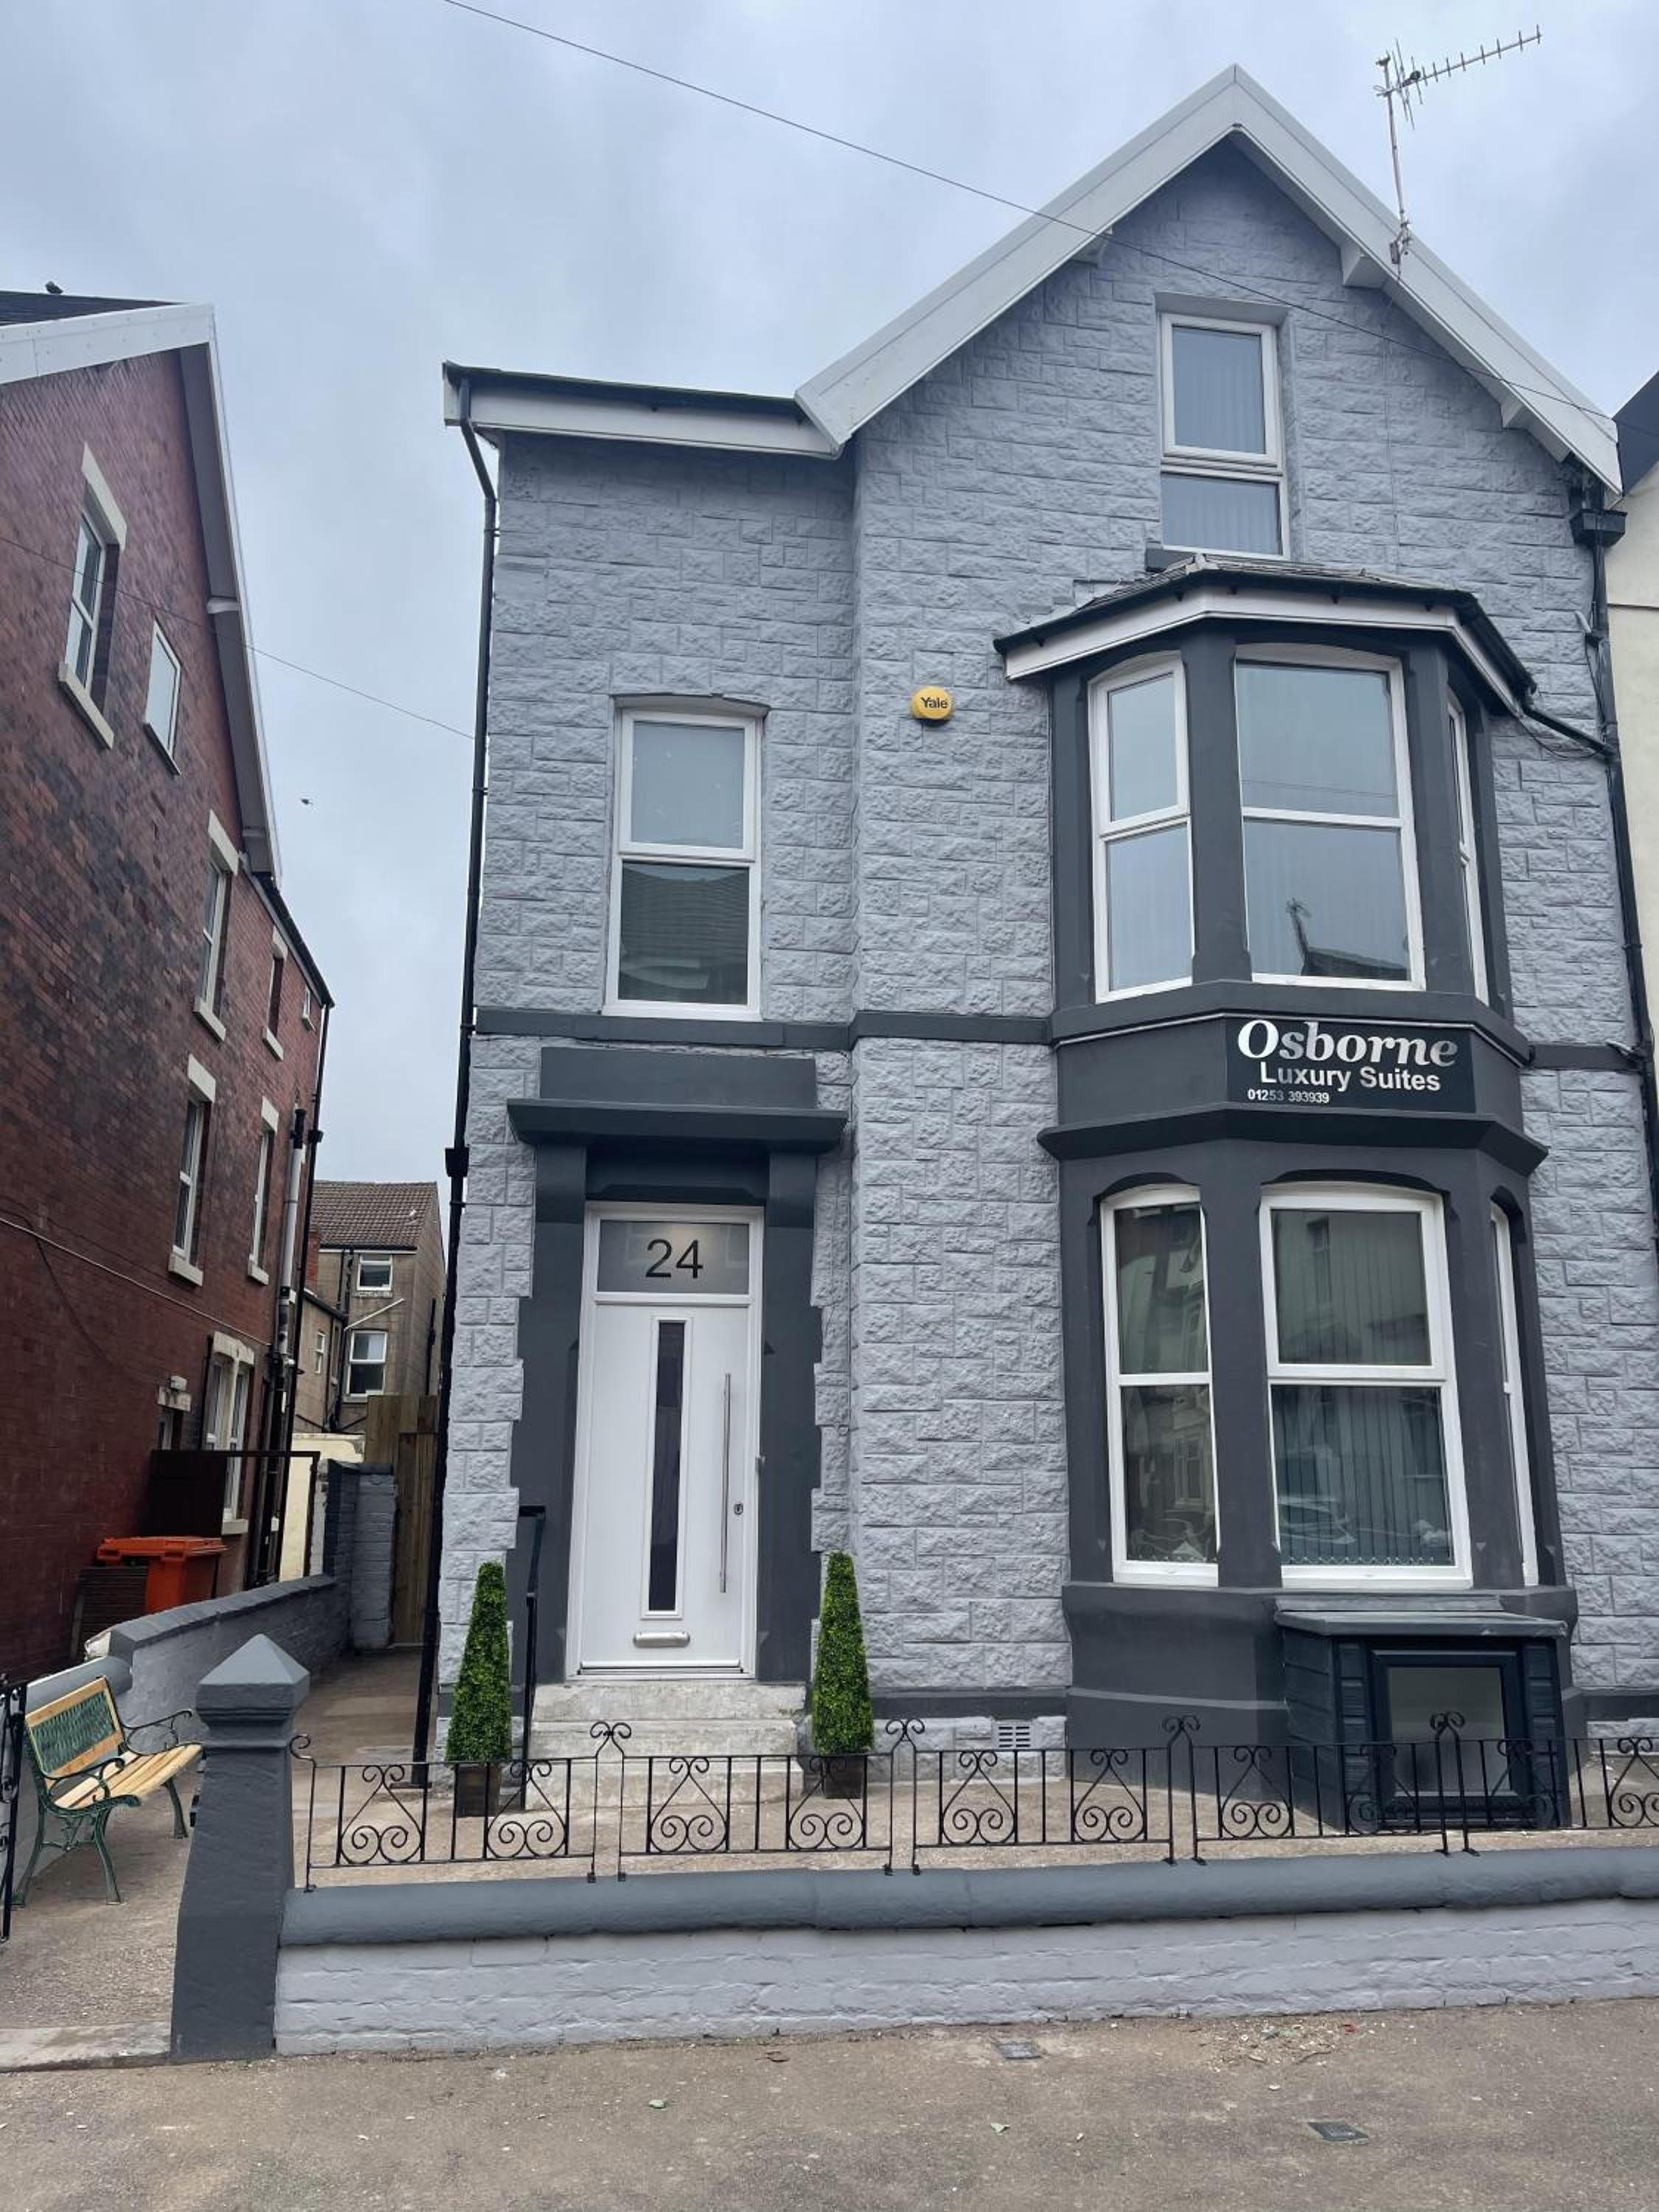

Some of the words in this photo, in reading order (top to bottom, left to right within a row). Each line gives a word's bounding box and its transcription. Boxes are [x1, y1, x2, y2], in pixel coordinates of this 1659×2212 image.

[920, 697, 947, 709] Yale
[1238, 1020, 1458, 1067] Osborne
[1260, 1062, 1351, 1092] Luxury
[1359, 1066, 1441, 1091] Suites
[1248, 1089, 1284, 1102] 01253
[645, 1239, 703, 1279] 24
